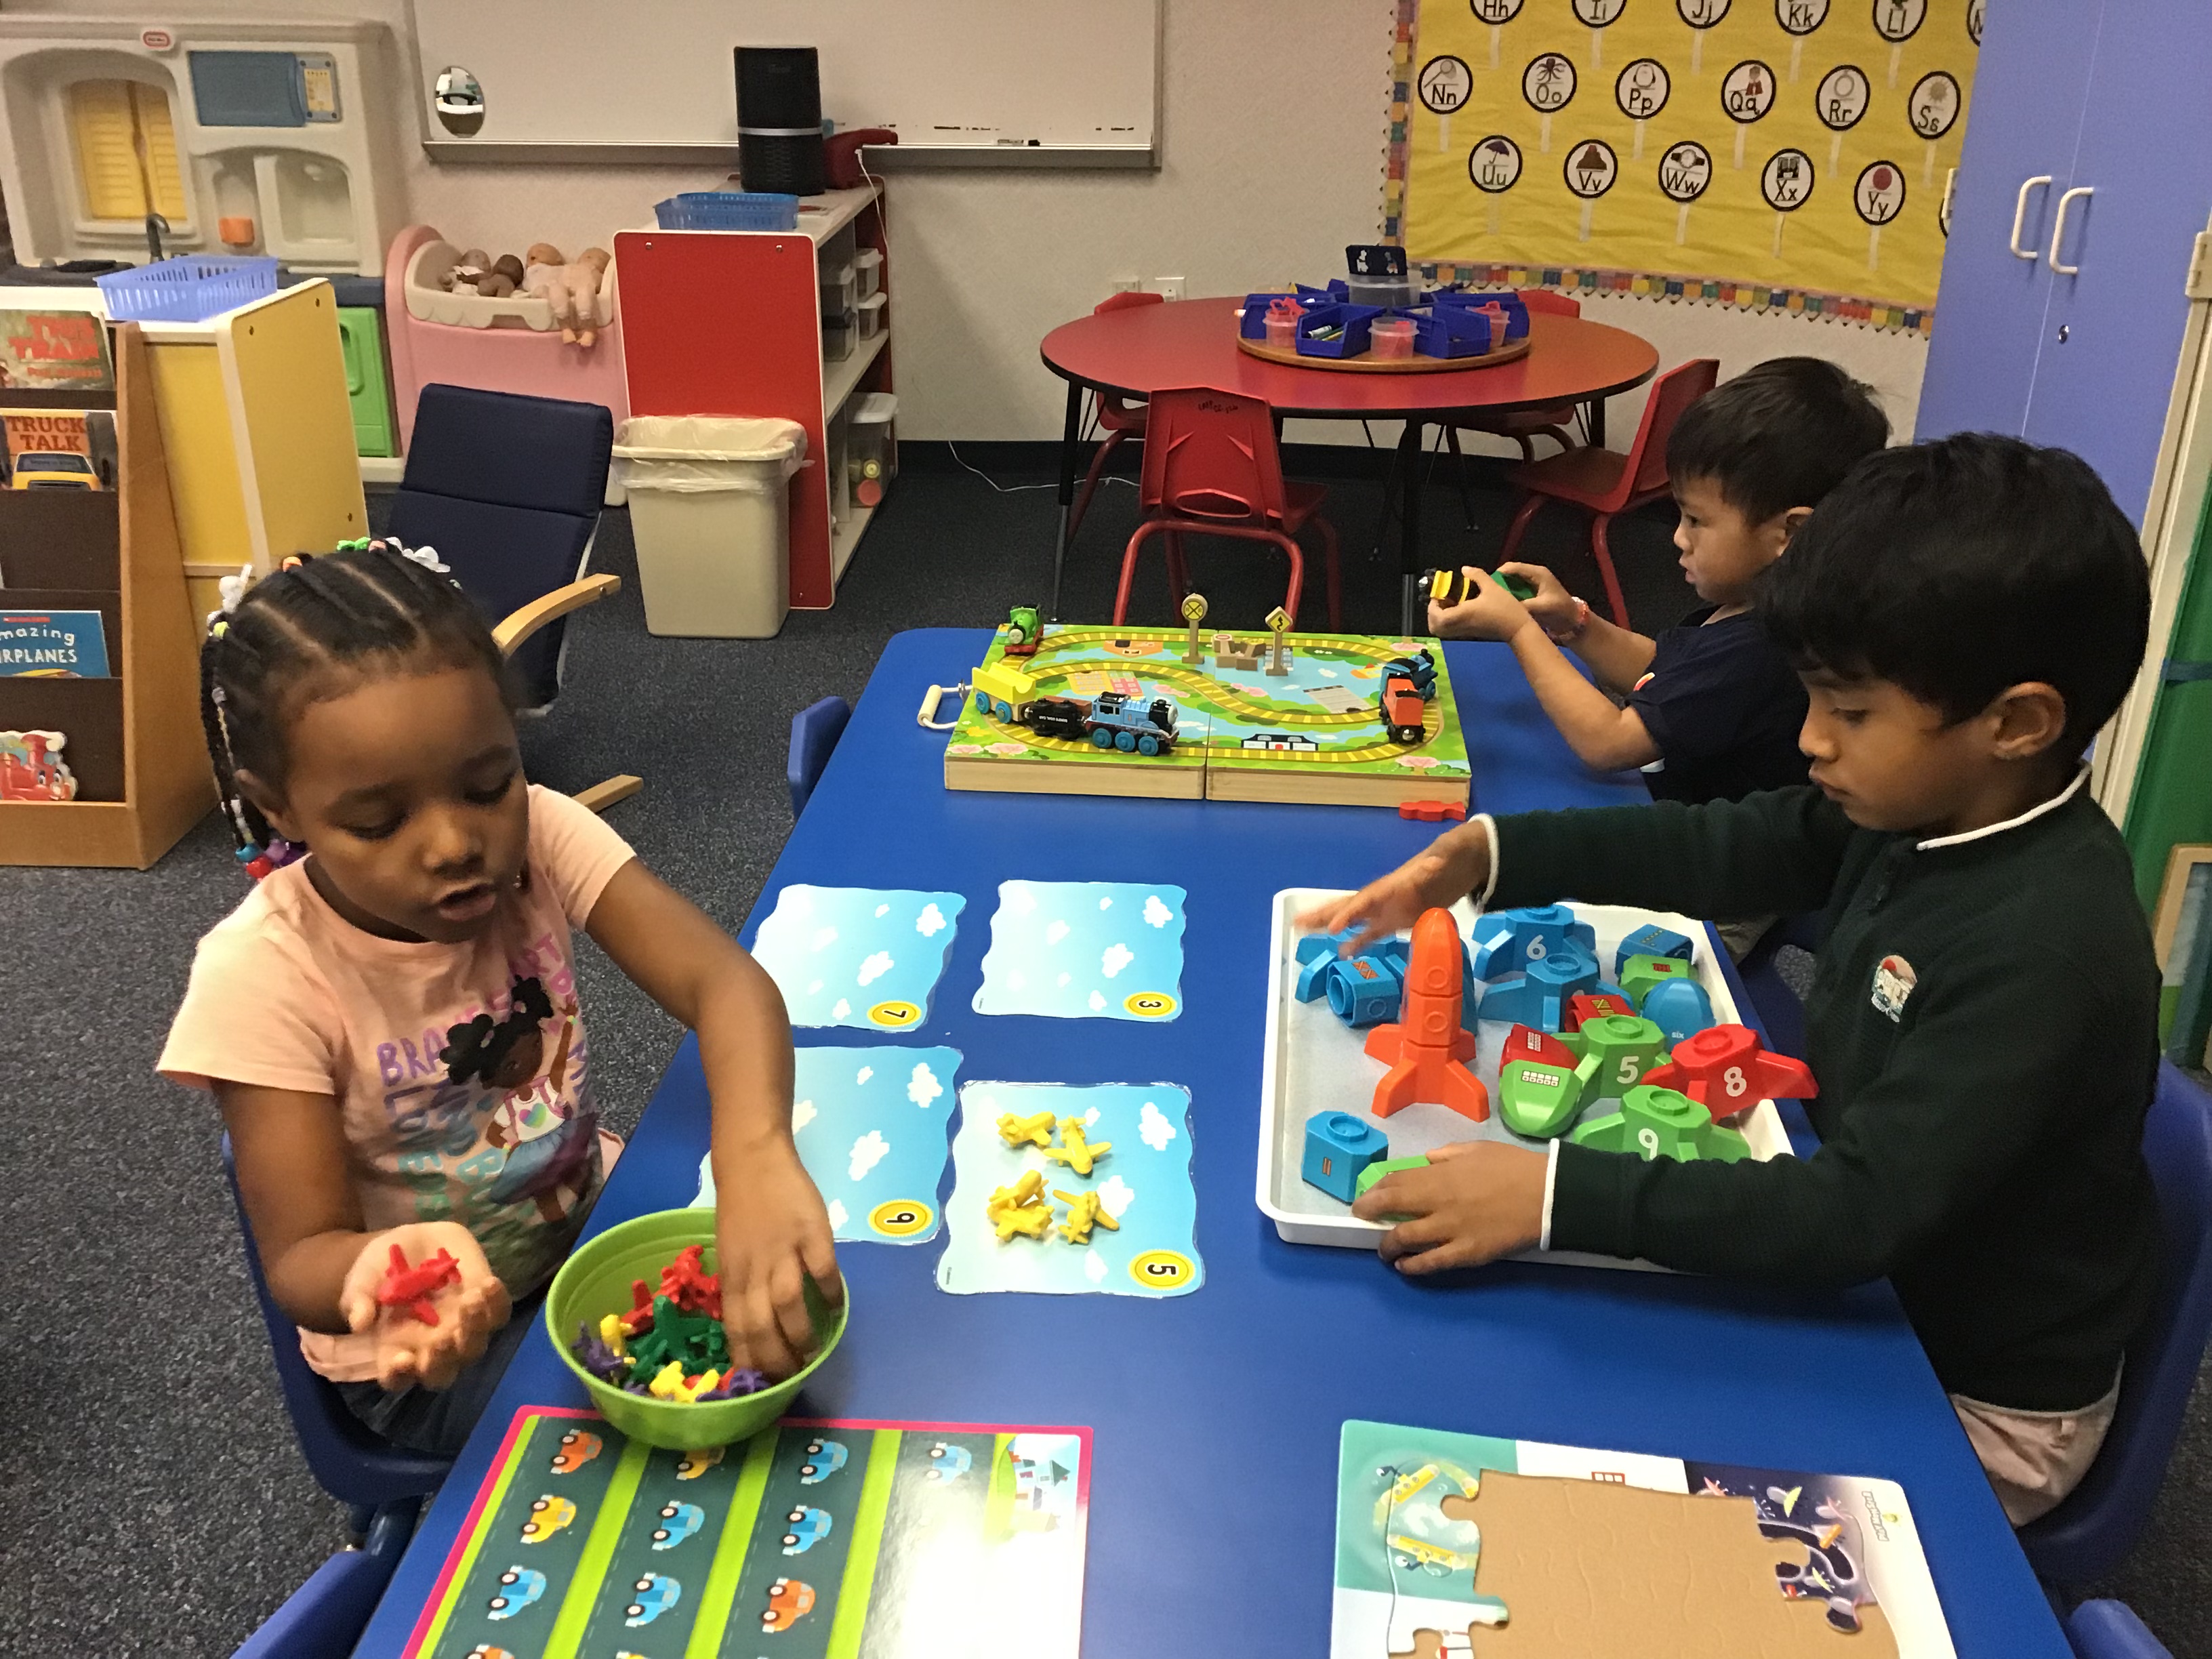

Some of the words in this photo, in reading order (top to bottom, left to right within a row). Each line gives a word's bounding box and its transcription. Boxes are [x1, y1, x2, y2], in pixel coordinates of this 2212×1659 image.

[1788, 5, 1814, 27] Kk
[1887, 9, 1907, 33] Ll
[1431, 85, 1457, 105] Nn
[1536, 83, 1562, 104] Oo
[1629, 88, 1653, 114] Pp
[1730, 91, 1760, 115] Qq
[1830, 99, 1851, 123] Rr
[1918, 106, 1938, 131] Ss
[1481, 165, 1507, 186] Uu
[1579, 171, 1601, 191] Vv
[1666, 168, 1699, 194] Ww
[1774, 179, 1797, 202] Xx
[1868, 191, 1889, 222] Yy
[6, 415, 85, 434] TRUCK
[20, 434, 81, 451] TALK
[1525, 934, 1547, 960] 6
[883, 1010, 907, 1019] 7
[1139, 1000, 1162, 1008] 3
[1671, 1031, 1685, 1039] six
[1616, 1055, 1639, 1084] 5
[1723, 1066, 1747, 1097] 8
[1638, 1128, 1659, 1162] 9
[1147, 1264, 1176, 1275] 5
